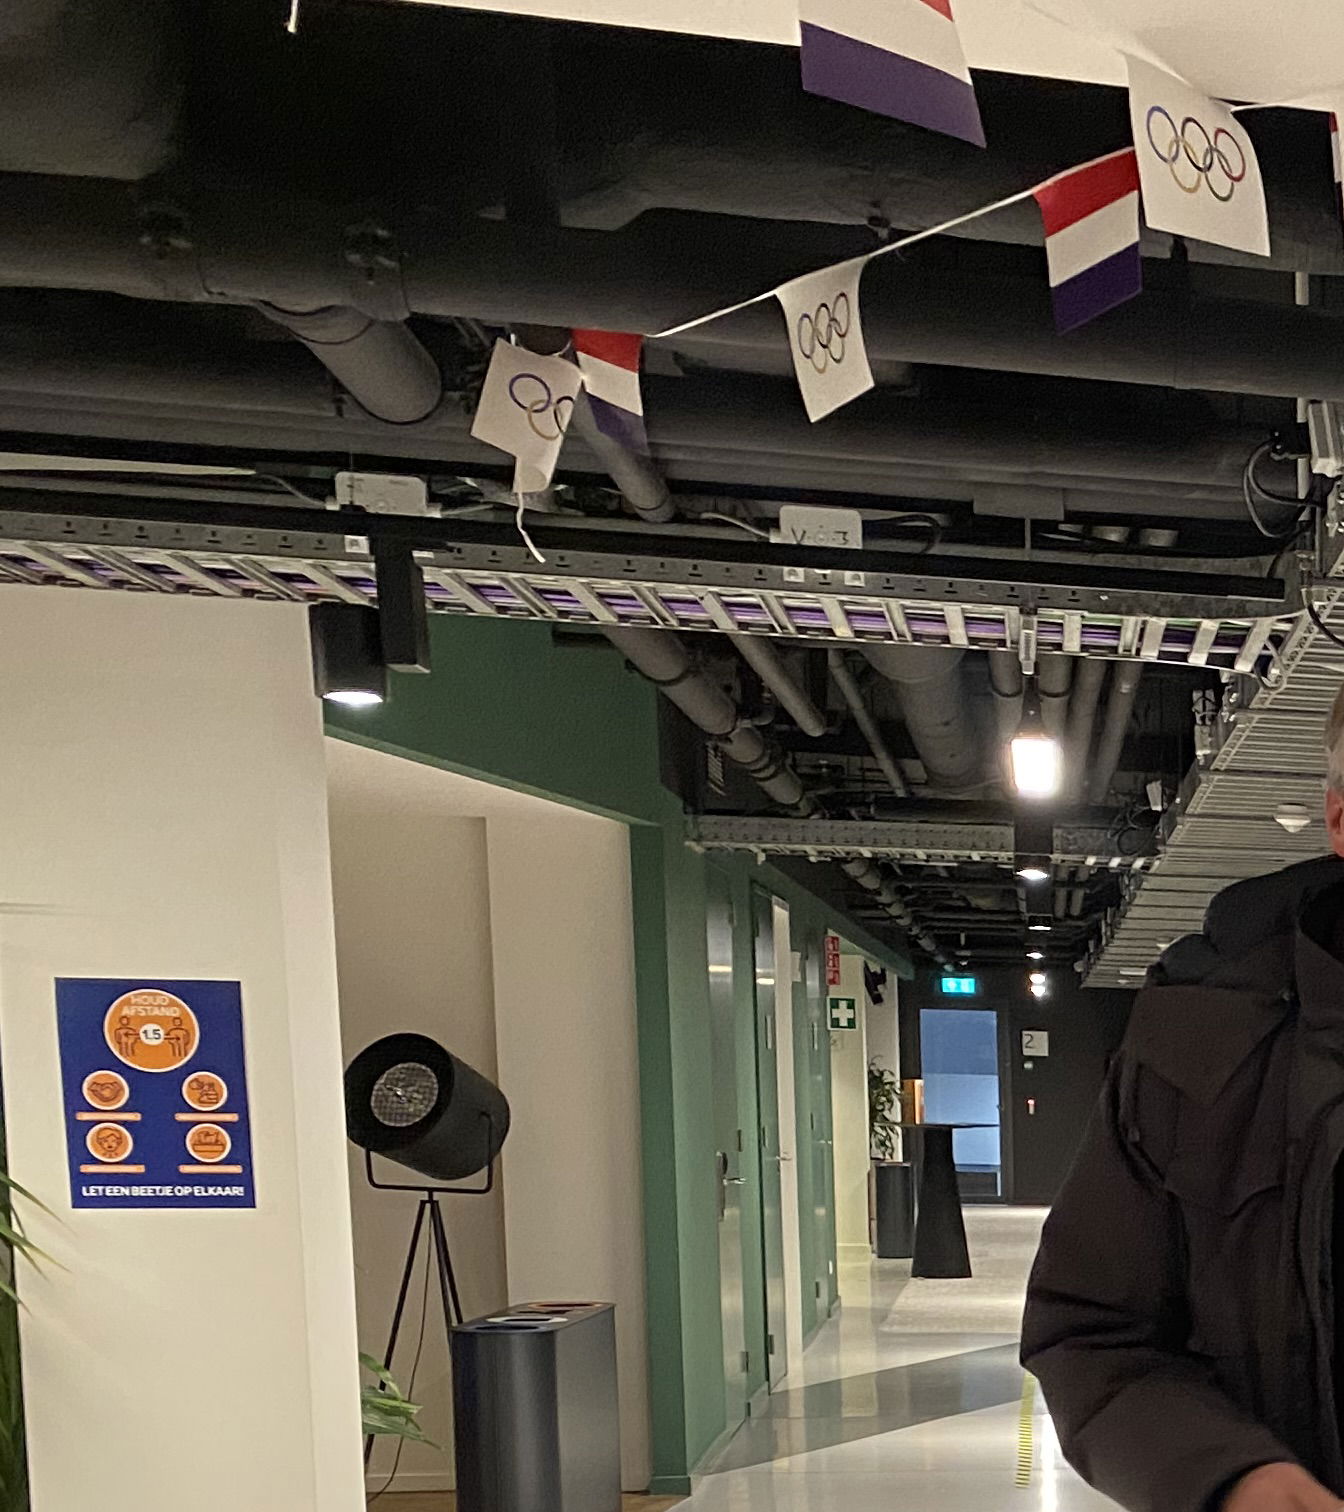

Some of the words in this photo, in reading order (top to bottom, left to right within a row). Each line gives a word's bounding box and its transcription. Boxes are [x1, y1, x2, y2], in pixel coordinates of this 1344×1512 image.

[130, 995, 169, 1005] HOUD
[82, 1186, 104, 1197] LET
[105, 1186, 130, 1197] EEN
[130, 1186, 173, 1197] BEETJE
[174, 1186, 192, 1197] OP
[193, 1186, 244, 1197] ELKAAR!
